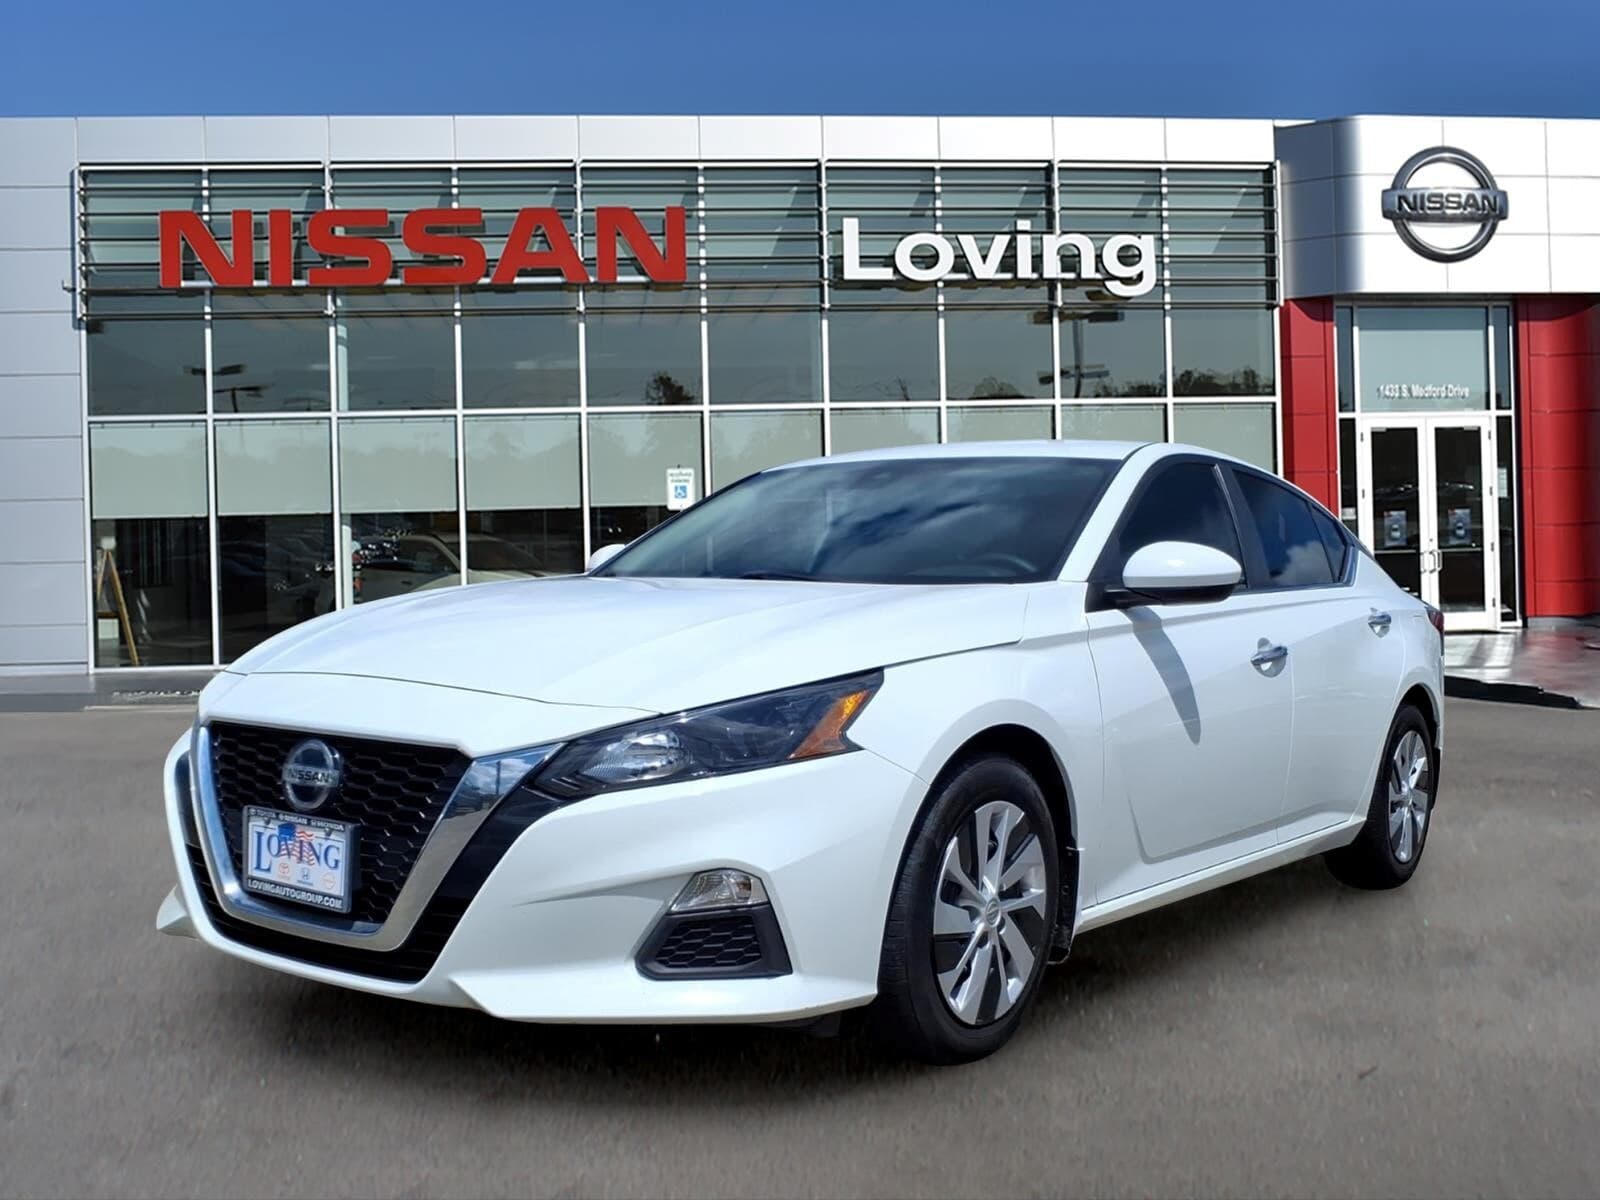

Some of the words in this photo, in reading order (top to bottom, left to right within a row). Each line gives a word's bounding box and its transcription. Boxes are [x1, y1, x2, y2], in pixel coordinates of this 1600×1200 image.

[1397, 192, 1498, 213] NISSAN
[159, 206, 687, 288] NISSAN
[842, 217, 1157, 297] Loving
[1411, 383, 1446, 398] Medford
[1447, 383, 1470, 398] Drive
[289, 767, 330, 783] NISSAN
[254, 830, 340, 874] LOVING
[247, 879, 343, 909] LOVINGAUTOGROUP.COM
